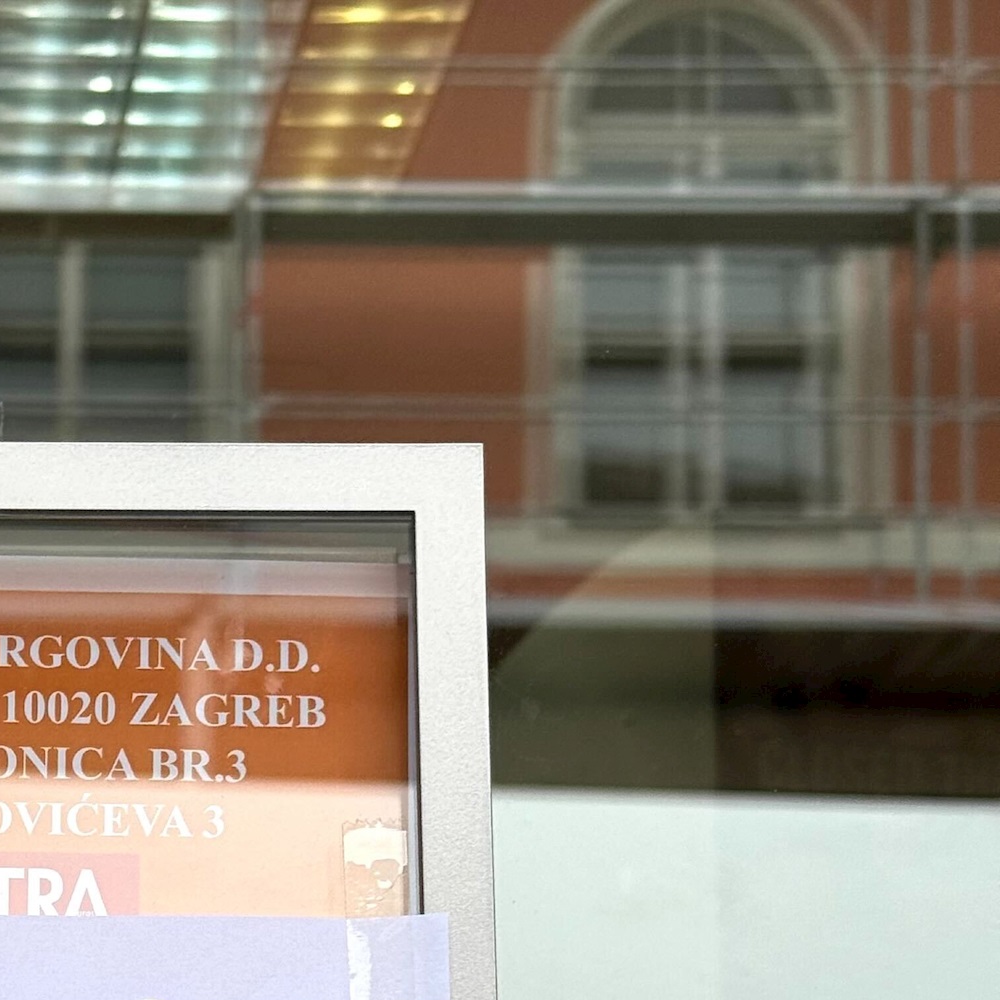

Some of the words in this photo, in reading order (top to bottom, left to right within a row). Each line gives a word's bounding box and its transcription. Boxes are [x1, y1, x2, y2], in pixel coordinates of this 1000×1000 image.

[230, 639, 320, 673] D.D.
[2, 690, 116, 725] 10020
[129, 693, 327, 728] ZAGREB
[148, 748, 248, 783] BR.3
[202, 804, 226, 839] 3
